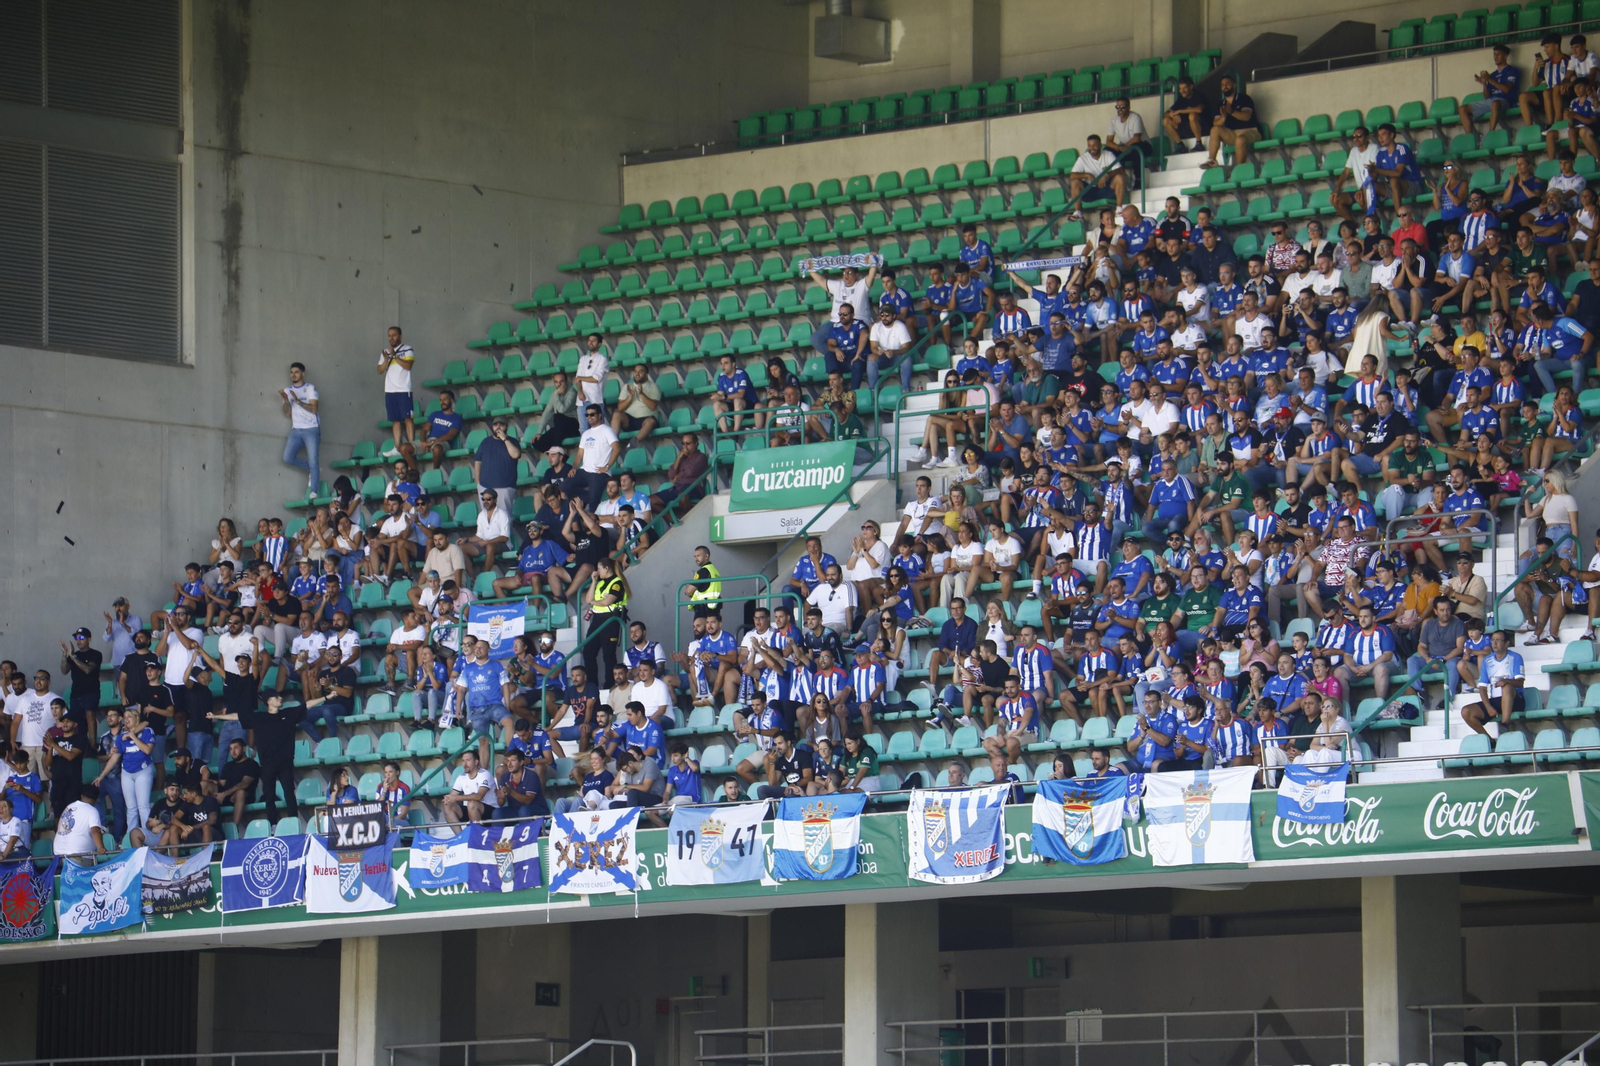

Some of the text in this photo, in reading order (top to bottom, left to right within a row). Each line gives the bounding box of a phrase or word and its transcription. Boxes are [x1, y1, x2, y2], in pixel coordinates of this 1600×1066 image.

[741, 464, 846, 493] Cruzcampo
[714, 519, 721, 538] 1
[780, 517, 803, 528] Salida
[332, 803, 382, 818] LA PENÚLTIMA
[1272, 796, 1382, 848] CocaCola
[1423, 786, 1539, 841] Coca-Cola
[336, 820, 381, 847] X.C.D
[245, 840, 287, 865] SHERRY ARMY
[554, 837, 630, 870] XEREZ
[954, 843, 1000, 867] XEREZ
[253, 862, 278, 874] XEREZ
[313, 865, 338, 876] Nueva
[259, 888, 273, 896] 1947
[73, 902, 111, 929] Pepe
